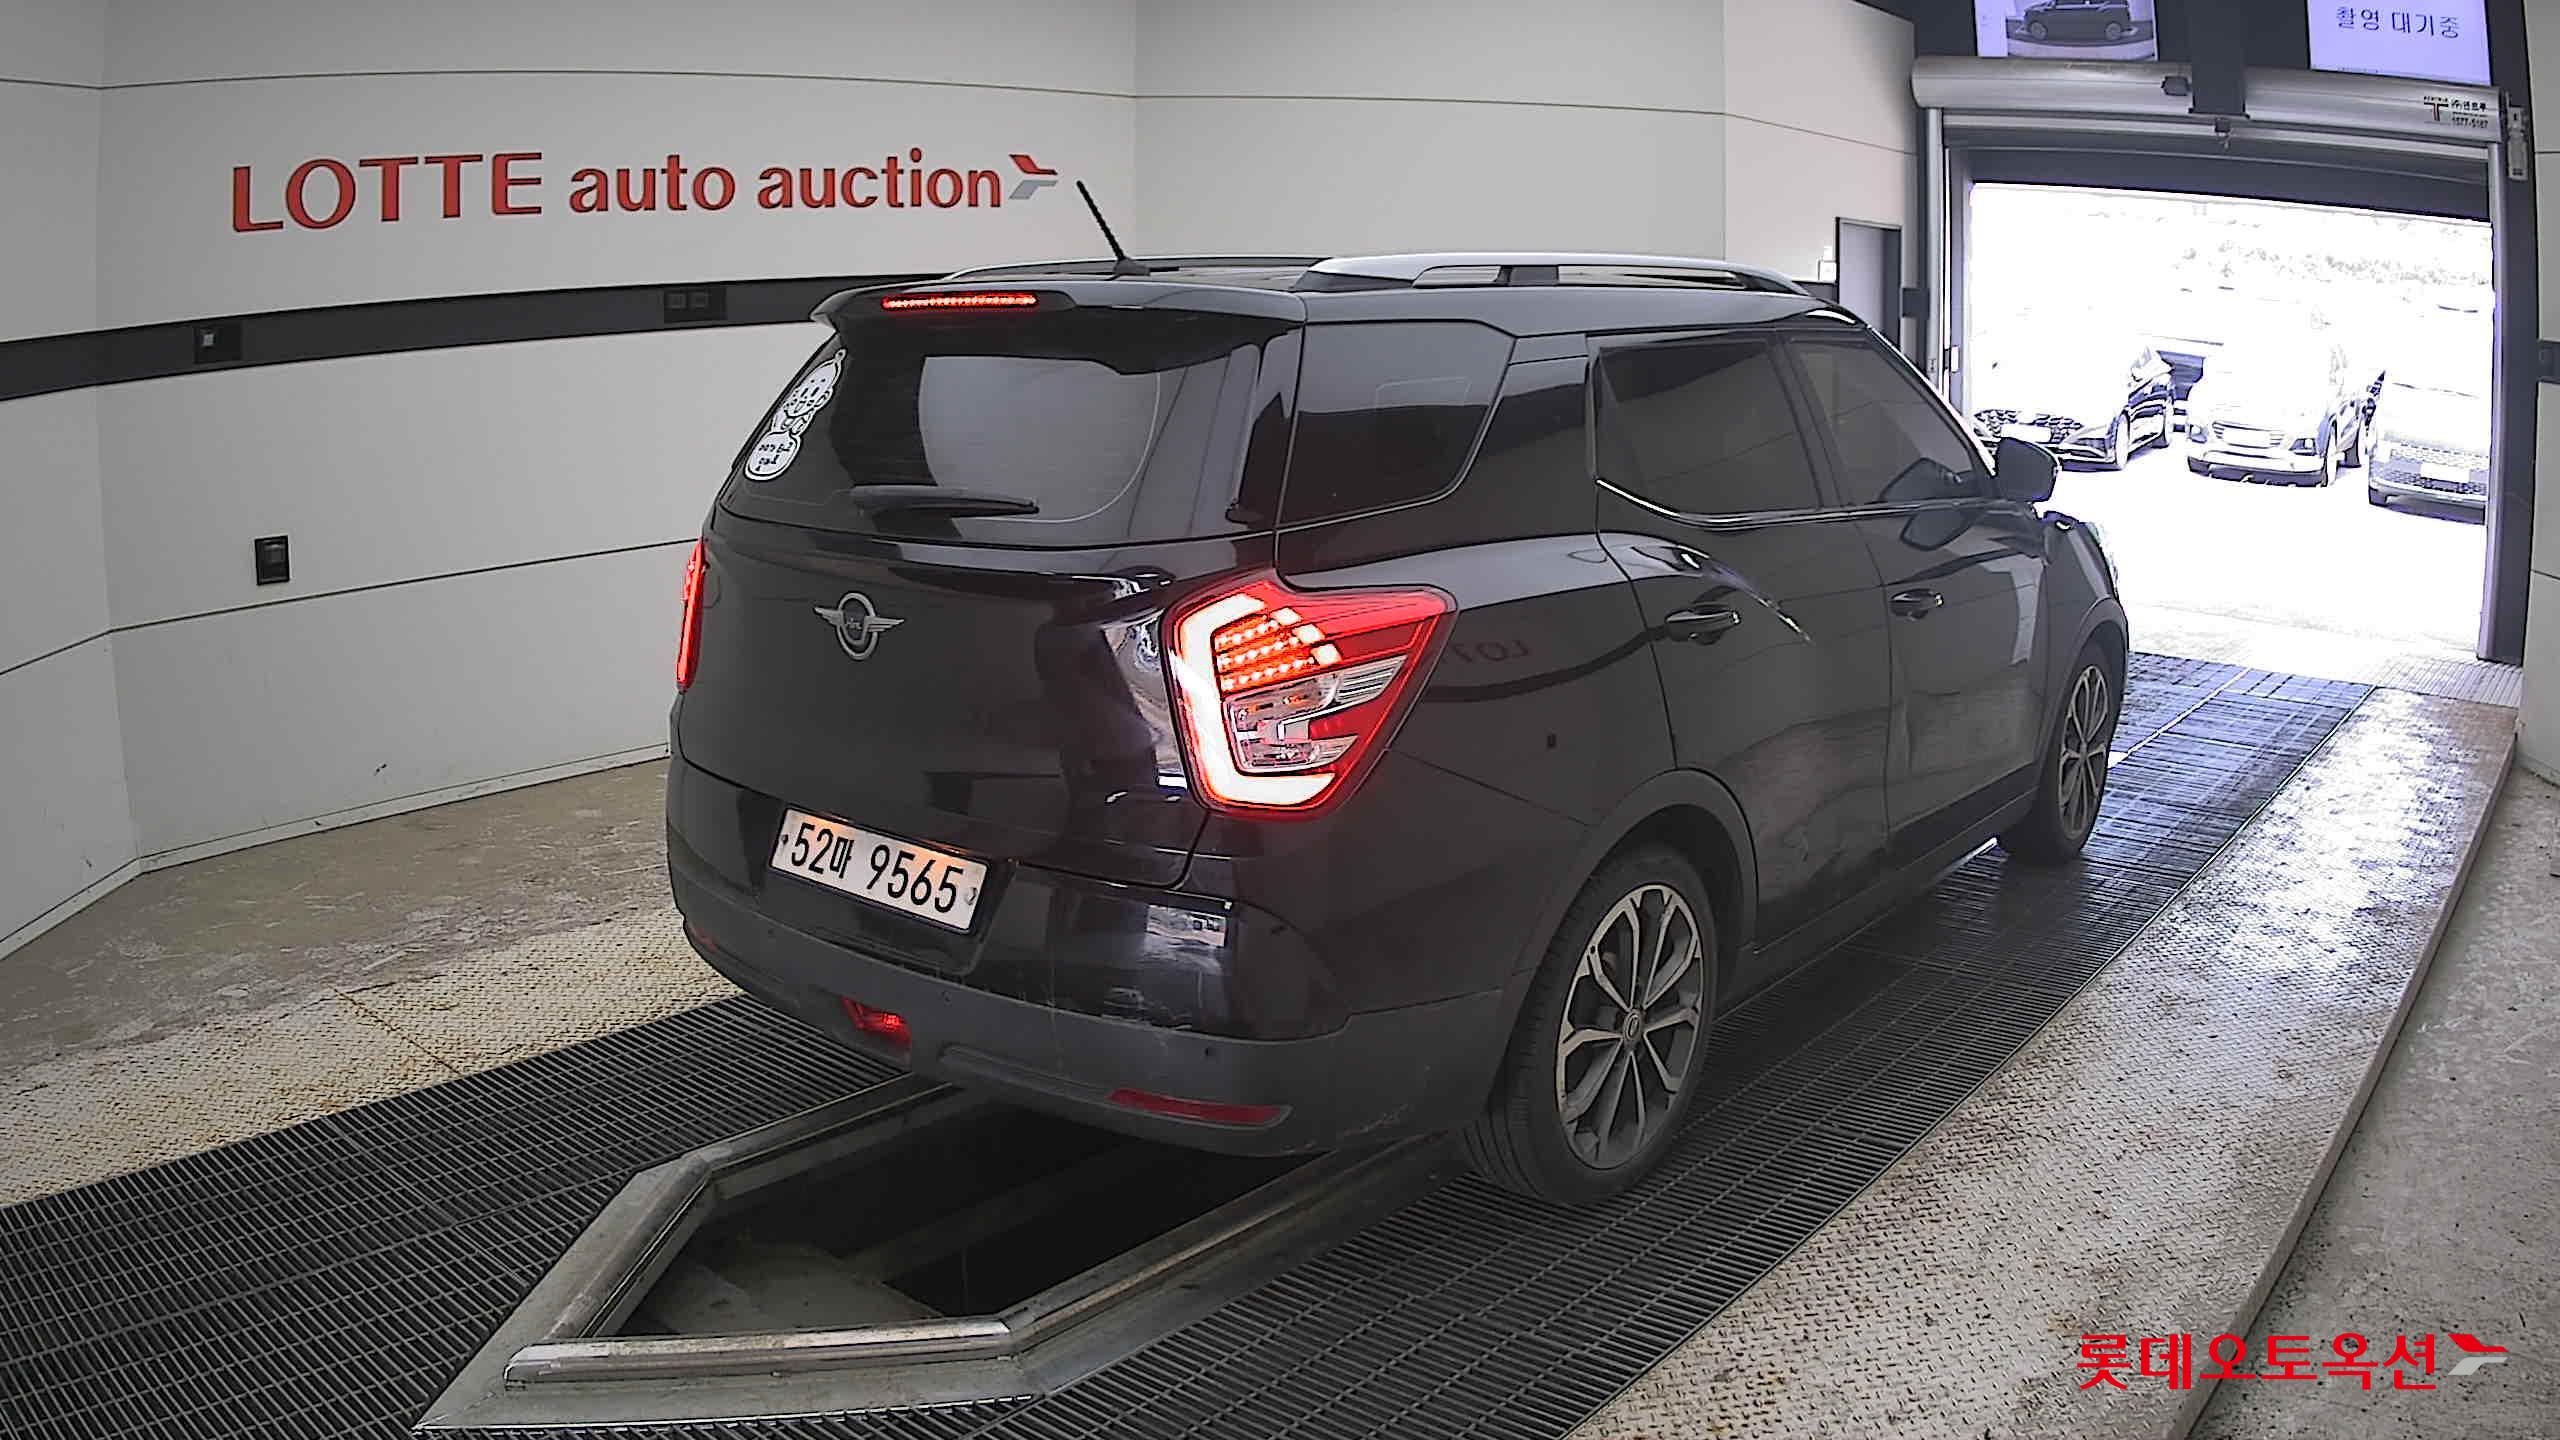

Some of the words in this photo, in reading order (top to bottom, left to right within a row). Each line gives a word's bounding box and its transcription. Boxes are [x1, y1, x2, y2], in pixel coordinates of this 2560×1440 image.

[2337, 7, 2380, 31] 촬영
[2391, 12, 2459, 39] 대기중
[233, 152, 542, 232] LOTTE
[570, 154, 736, 212] auto
[758, 148, 1003, 208] auction
[791, 822, 855, 879] 52마
[866, 844, 964, 913] 9565
